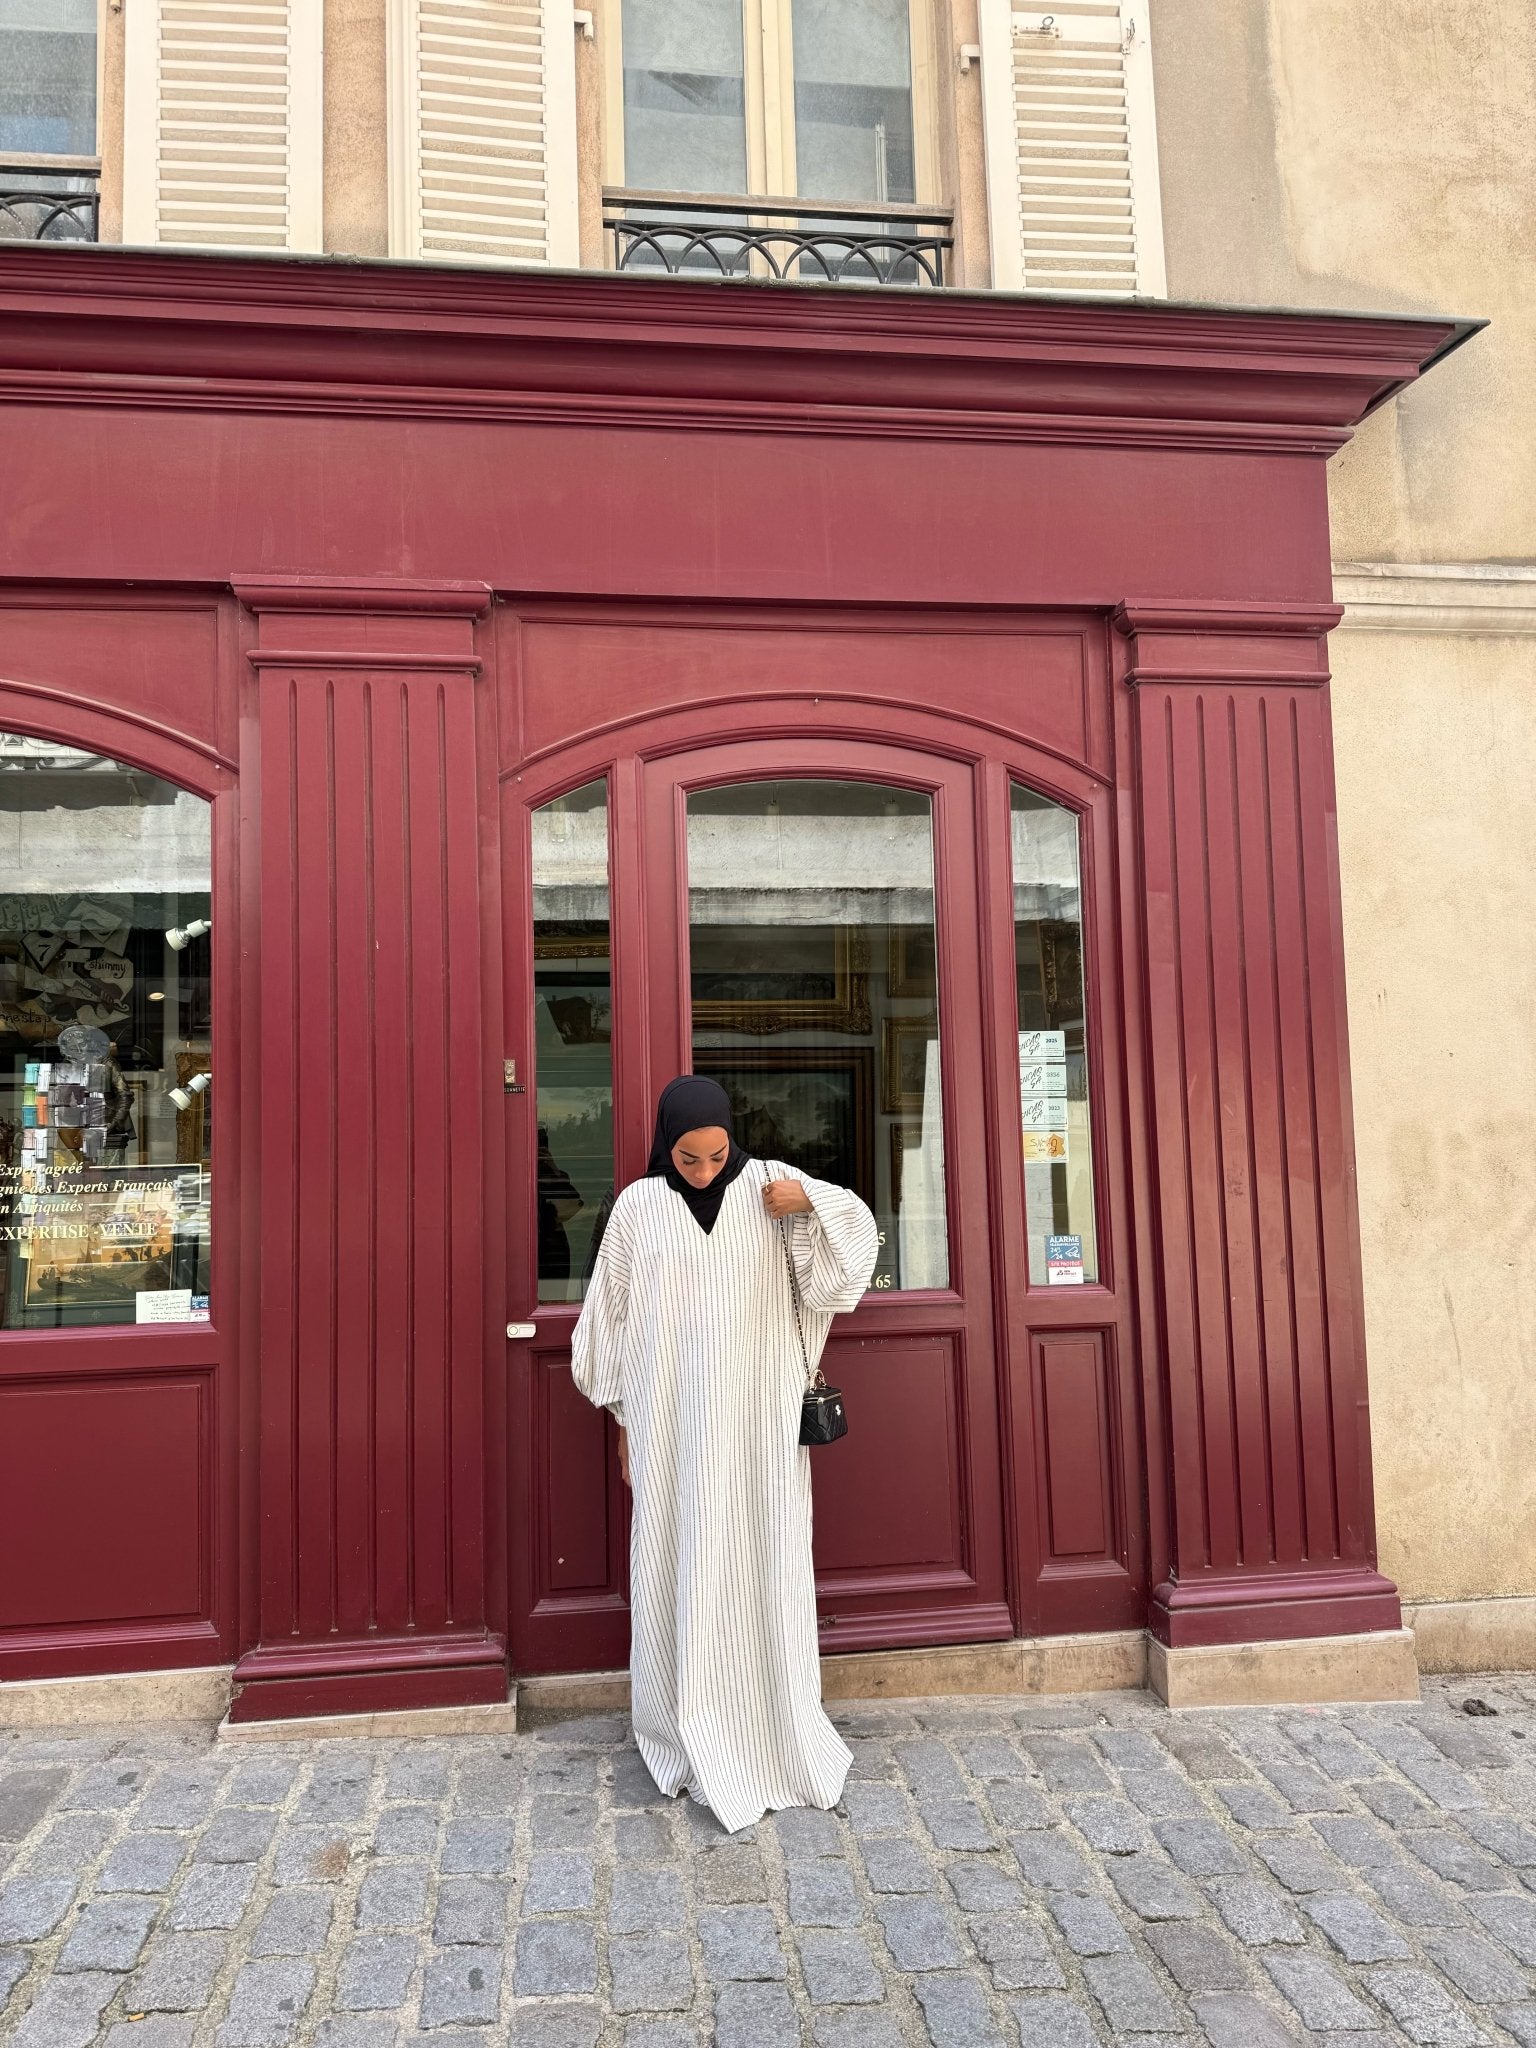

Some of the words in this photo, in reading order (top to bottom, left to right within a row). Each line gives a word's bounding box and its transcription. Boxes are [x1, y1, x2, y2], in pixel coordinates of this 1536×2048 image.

[45, 1161, 84, 1178] agréé
[30, 1182, 52, 1194] des
[56, 1181, 109, 1196] Experts
[112, 1178, 173, 1193] Français
[12, 1199, 84, 1215] Antiquités
[875, 1274, 891, 1288] 65
